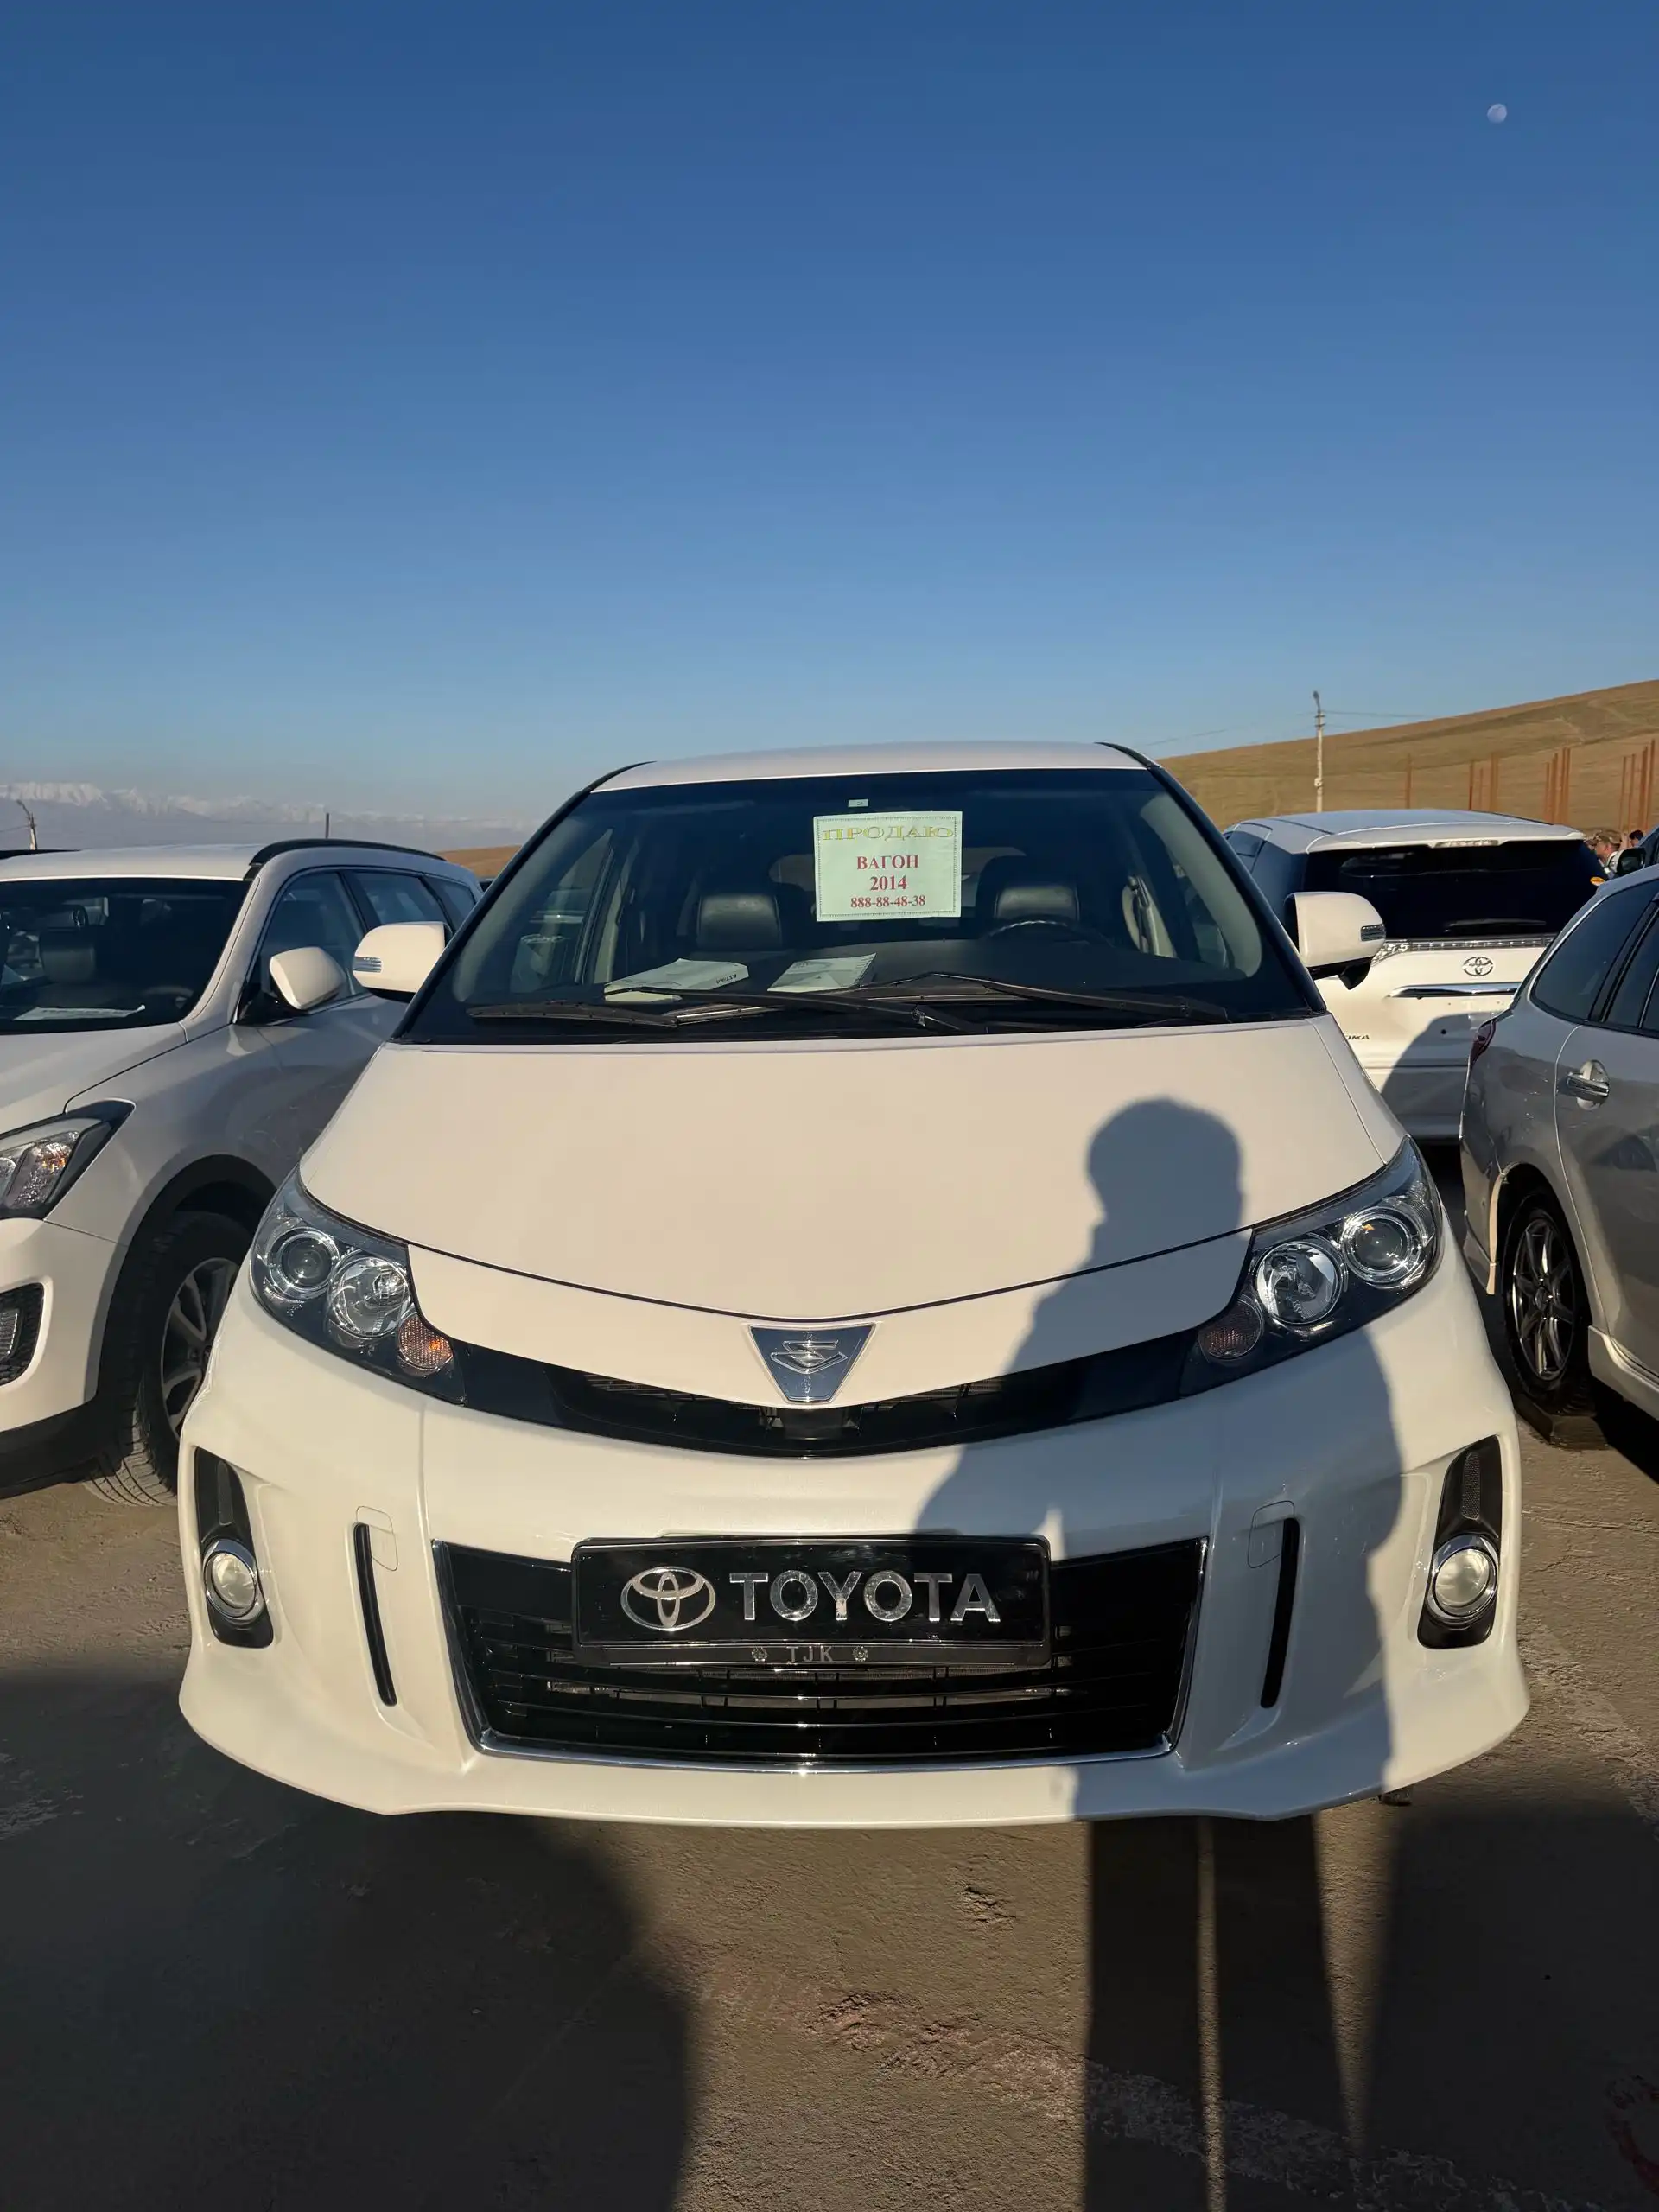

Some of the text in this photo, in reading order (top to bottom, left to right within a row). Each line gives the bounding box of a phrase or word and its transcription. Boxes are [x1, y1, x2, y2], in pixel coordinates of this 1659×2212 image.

[823, 825, 954, 841] ПРОДАЮ
[856, 855, 919, 869] ВАГОН
[870, 875, 907, 890] 2014
[850, 895, 925, 908] 888-88-48-38
[729, 1570, 1001, 1623] TOYOTA
[786, 1645, 833, 1663] TJK
